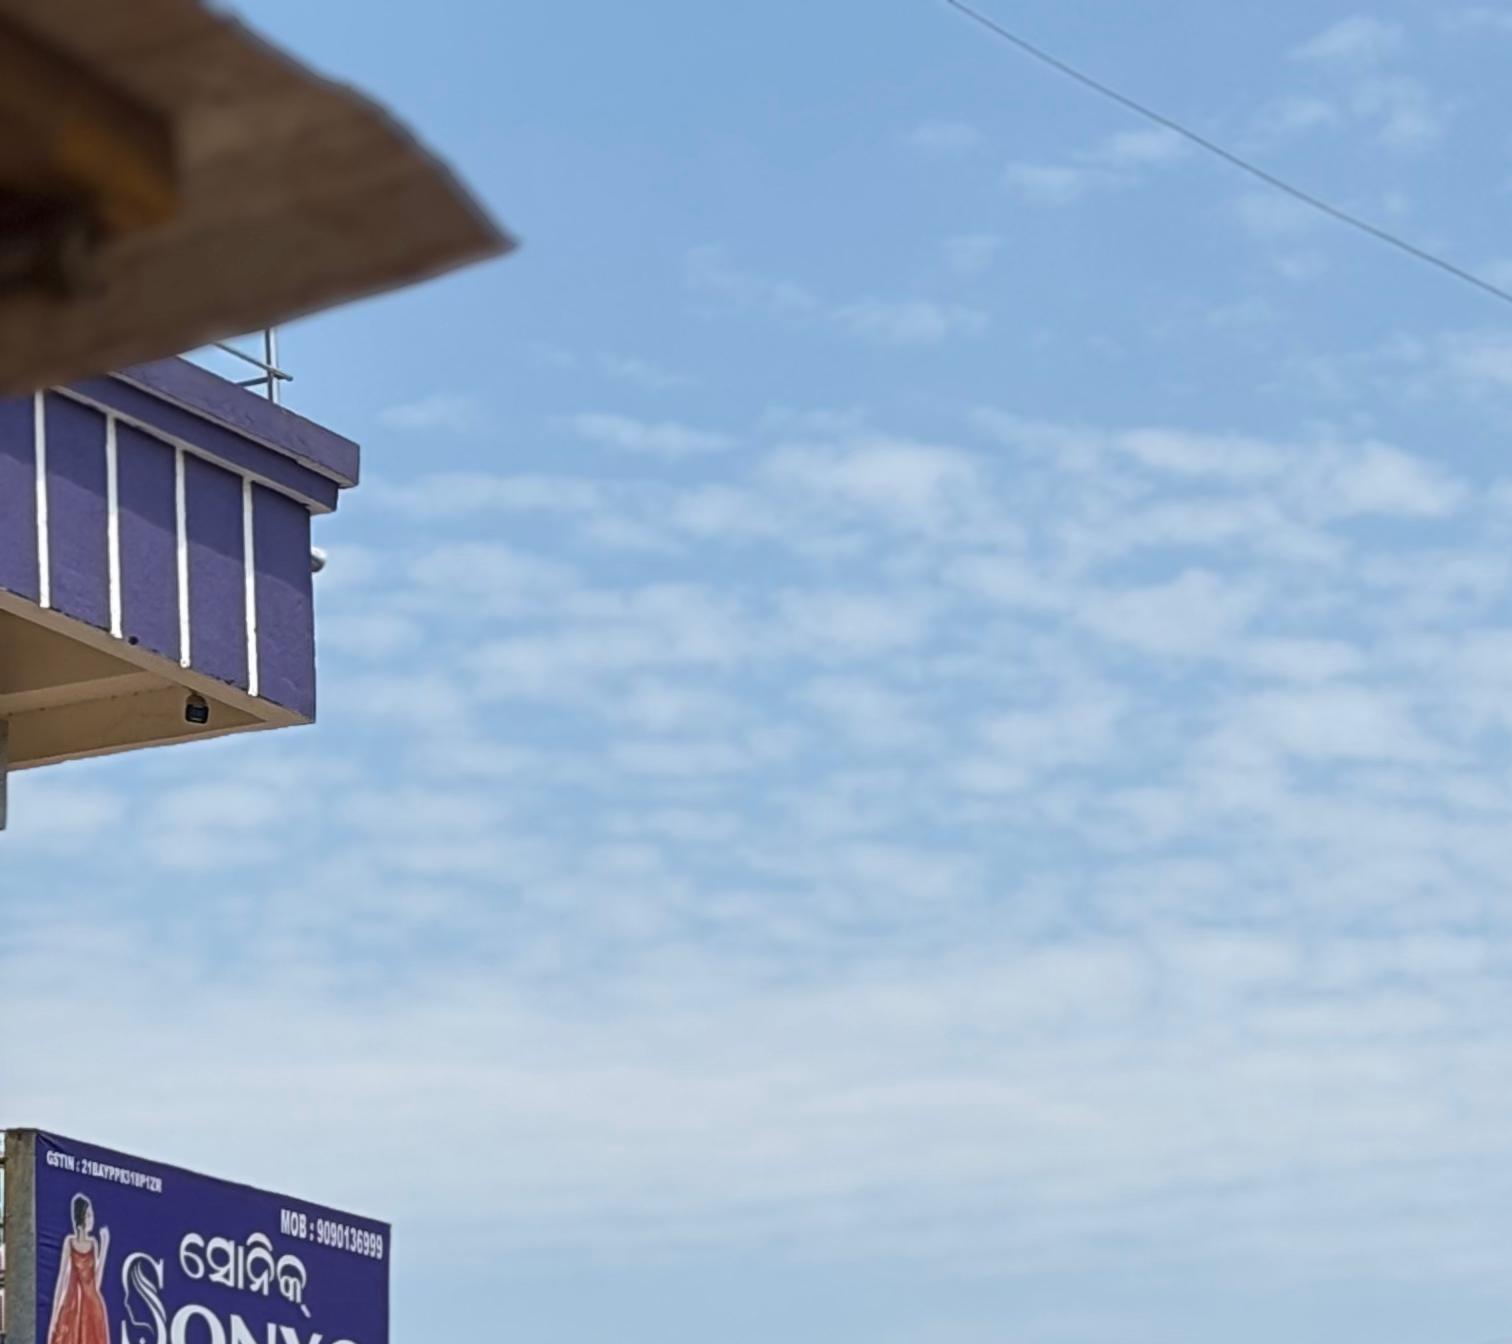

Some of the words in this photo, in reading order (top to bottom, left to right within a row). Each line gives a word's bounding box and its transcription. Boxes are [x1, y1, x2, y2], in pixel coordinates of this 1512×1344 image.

[46, 1151, 75, 1171] GSTIN
[281, 1209, 307, 1239] MOB
[317, 1218, 383, 1260] 9090136999
